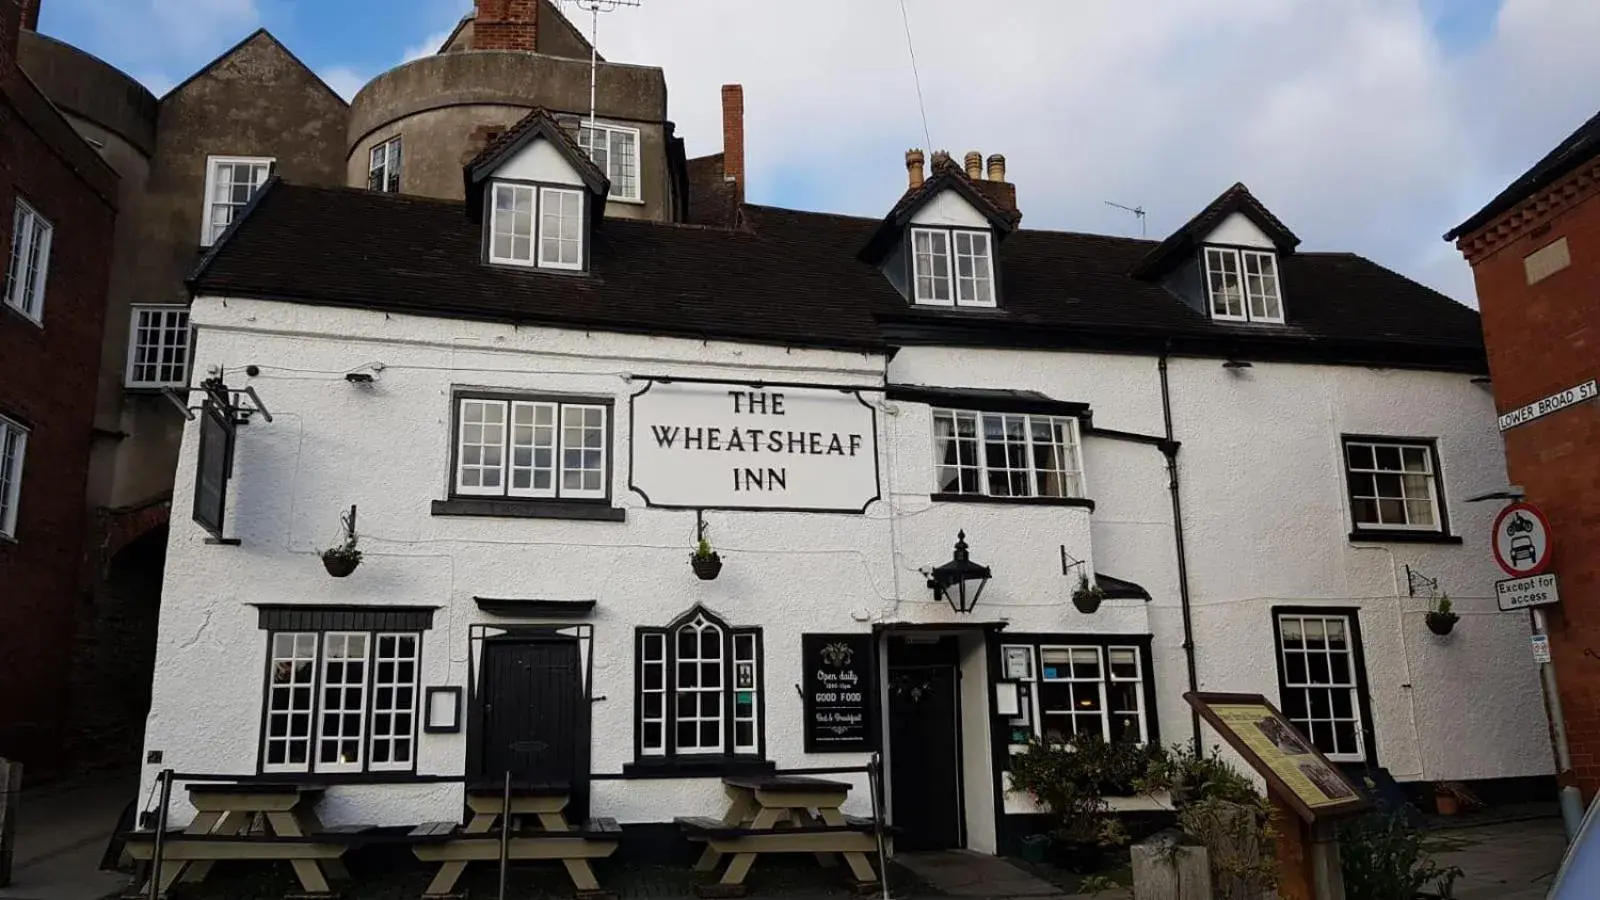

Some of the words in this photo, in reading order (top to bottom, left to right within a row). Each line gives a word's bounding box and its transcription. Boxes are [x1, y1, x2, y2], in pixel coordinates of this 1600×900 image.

[728, 391, 785, 415] THE
[1501, 406, 1534, 428] LOWER
[1538, 390, 1574, 413] BROAD
[650, 425, 862, 457] WHEATSHEAF
[733, 467, 786, 491] INN
[1499, 578, 1535, 594] Except
[1538, 577, 1553, 587] for
[1511, 592, 1547, 604] access
[817, 669, 837, 684] Open
[839, 670, 858, 685] daily
[816, 692, 836, 702] GOOD
[840, 692, 861, 702] FOOD
